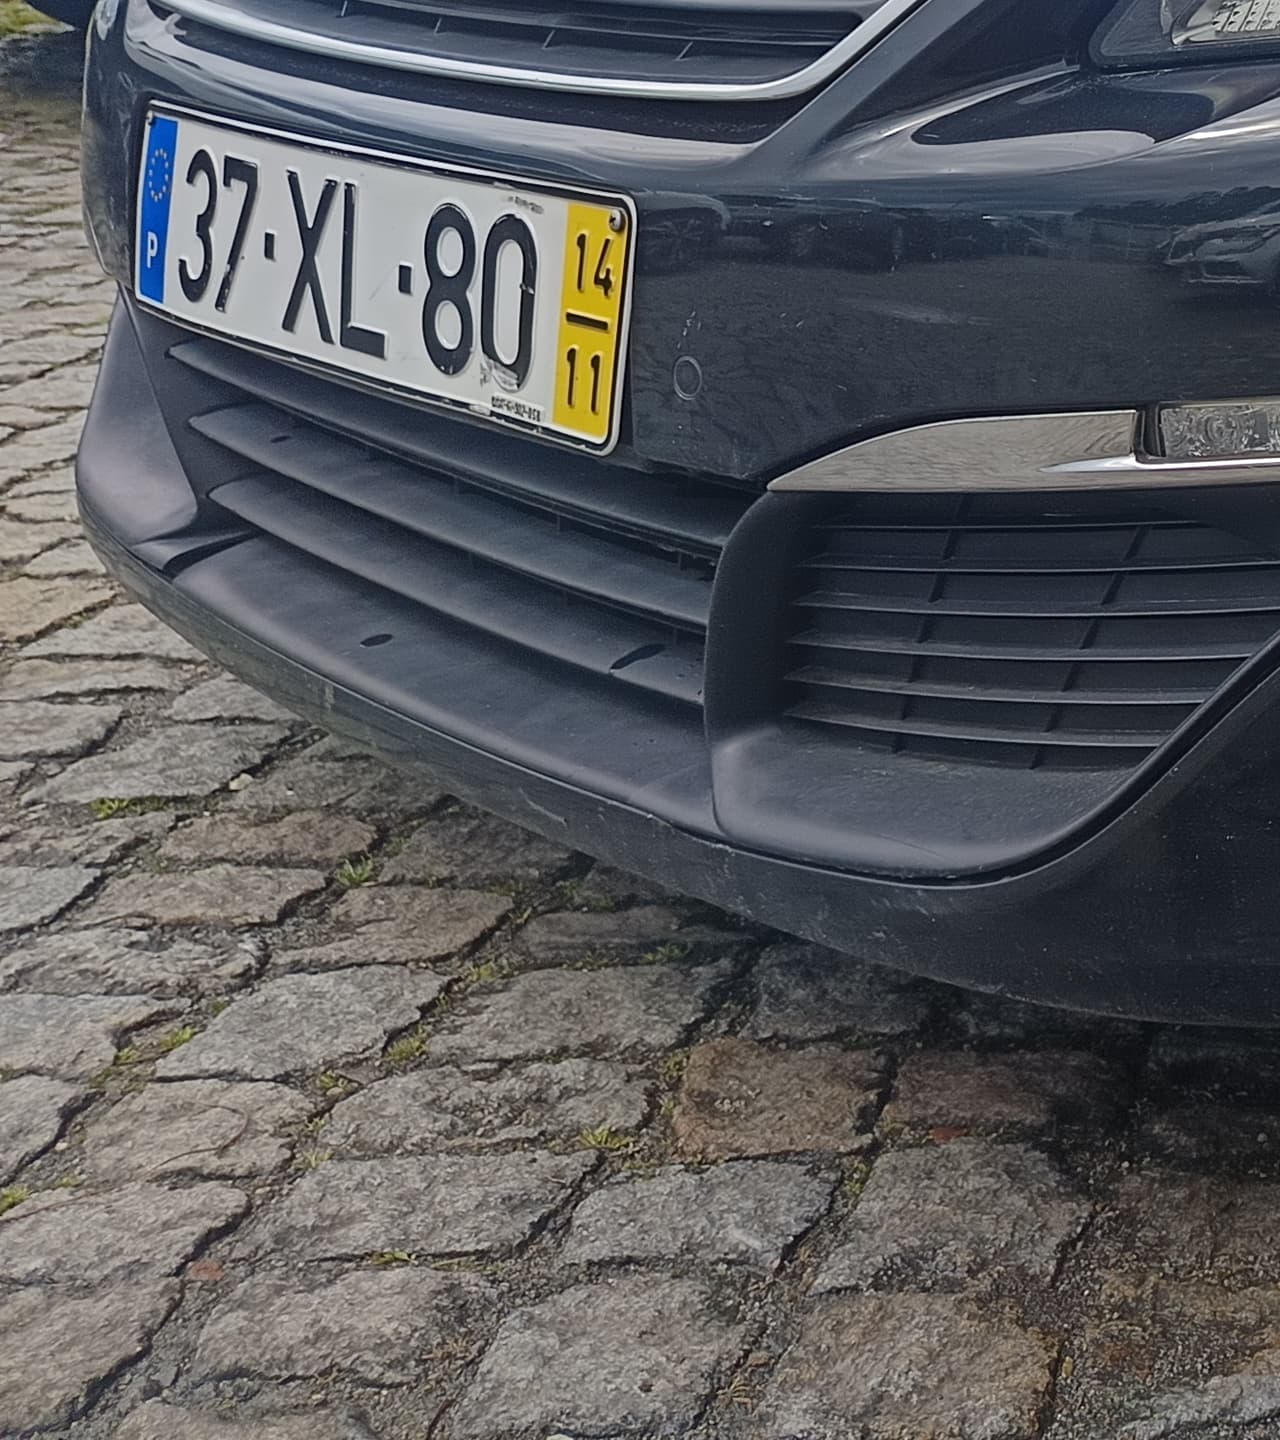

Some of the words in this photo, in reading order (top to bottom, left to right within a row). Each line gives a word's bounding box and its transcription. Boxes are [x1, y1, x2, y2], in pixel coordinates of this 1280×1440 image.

[146, 231, 158, 268] P
[575, 232, 616, 297] 14
[566, 346, 602, 415] 11
